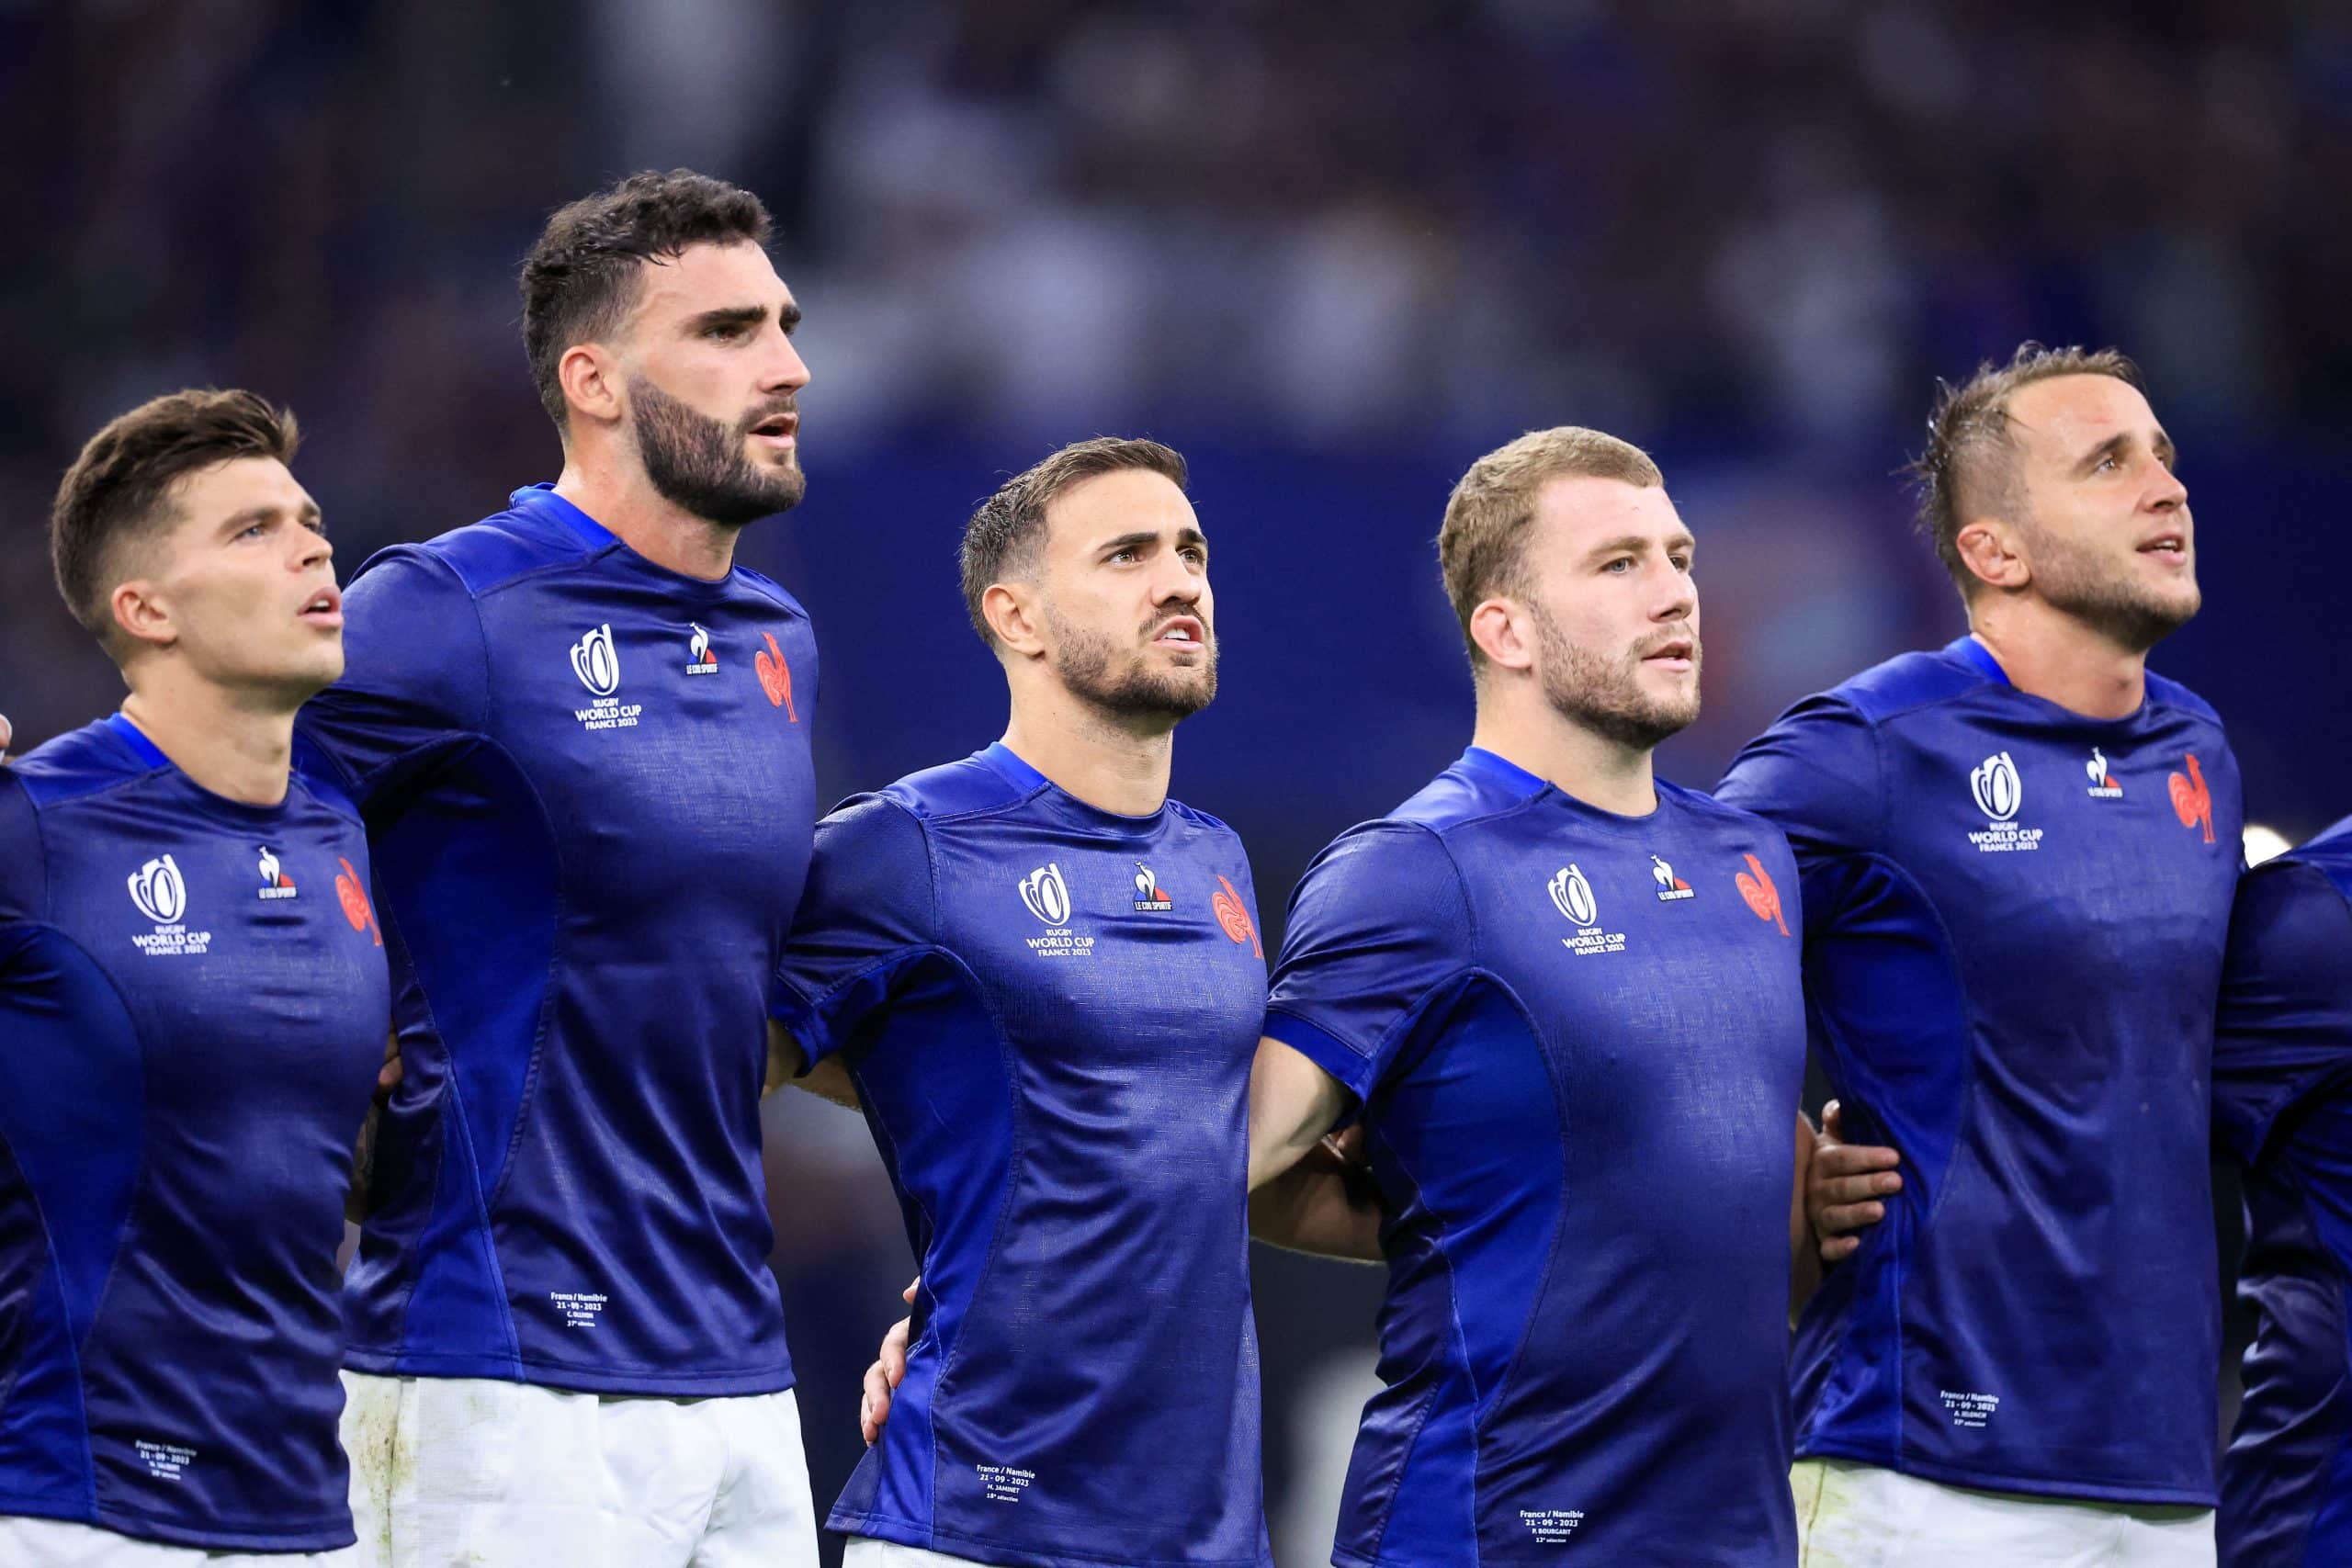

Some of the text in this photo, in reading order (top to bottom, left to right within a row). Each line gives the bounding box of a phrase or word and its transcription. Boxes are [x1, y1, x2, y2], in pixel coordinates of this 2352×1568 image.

[593, 697, 619, 707] RUGBY
[575, 705, 642, 722] WORLD CUP
[584, 716, 639, 730] FRANCE 2023
[1989, 821, 2018, 831] RUGBY
[1968, 829, 2043, 844] WORLD CUP
[1979, 840, 2039, 852] FRANCE 2023
[154, 924, 187, 934] RUGBY
[1046, 929, 1073, 937] RUGBY
[1577, 927, 1603, 936] RUGBY
[131, 931, 211, 948] WORLD CUP
[1026, 936, 1095, 949] WORLD CUP
[1561, 932, 1626, 949] WORLD CUP
[144, 943, 208, 955] FRANCE 2023
[1037, 948, 1091, 957] FRANCE 2023
[1575, 942, 1625, 956] FRANCE 2023
[550, 1292, 573, 1301] France
[556, 1301, 566, 1309] 21
[583, 1303, 602, 1311] 2023
[977, 1464, 999, 1473] France
[1006, 1467, 1035, 1479] Namibie
[1011, 1477, 1029, 1487] 2023
[994, 1484, 1020, 1494] JAMINET
[1520, 1509, 1546, 1518] France
[1525, 1518, 1535, 1527] 21
[1542, 1518, 1554, 1527] 09
[1559, 1519, 1578, 1528] 2023
